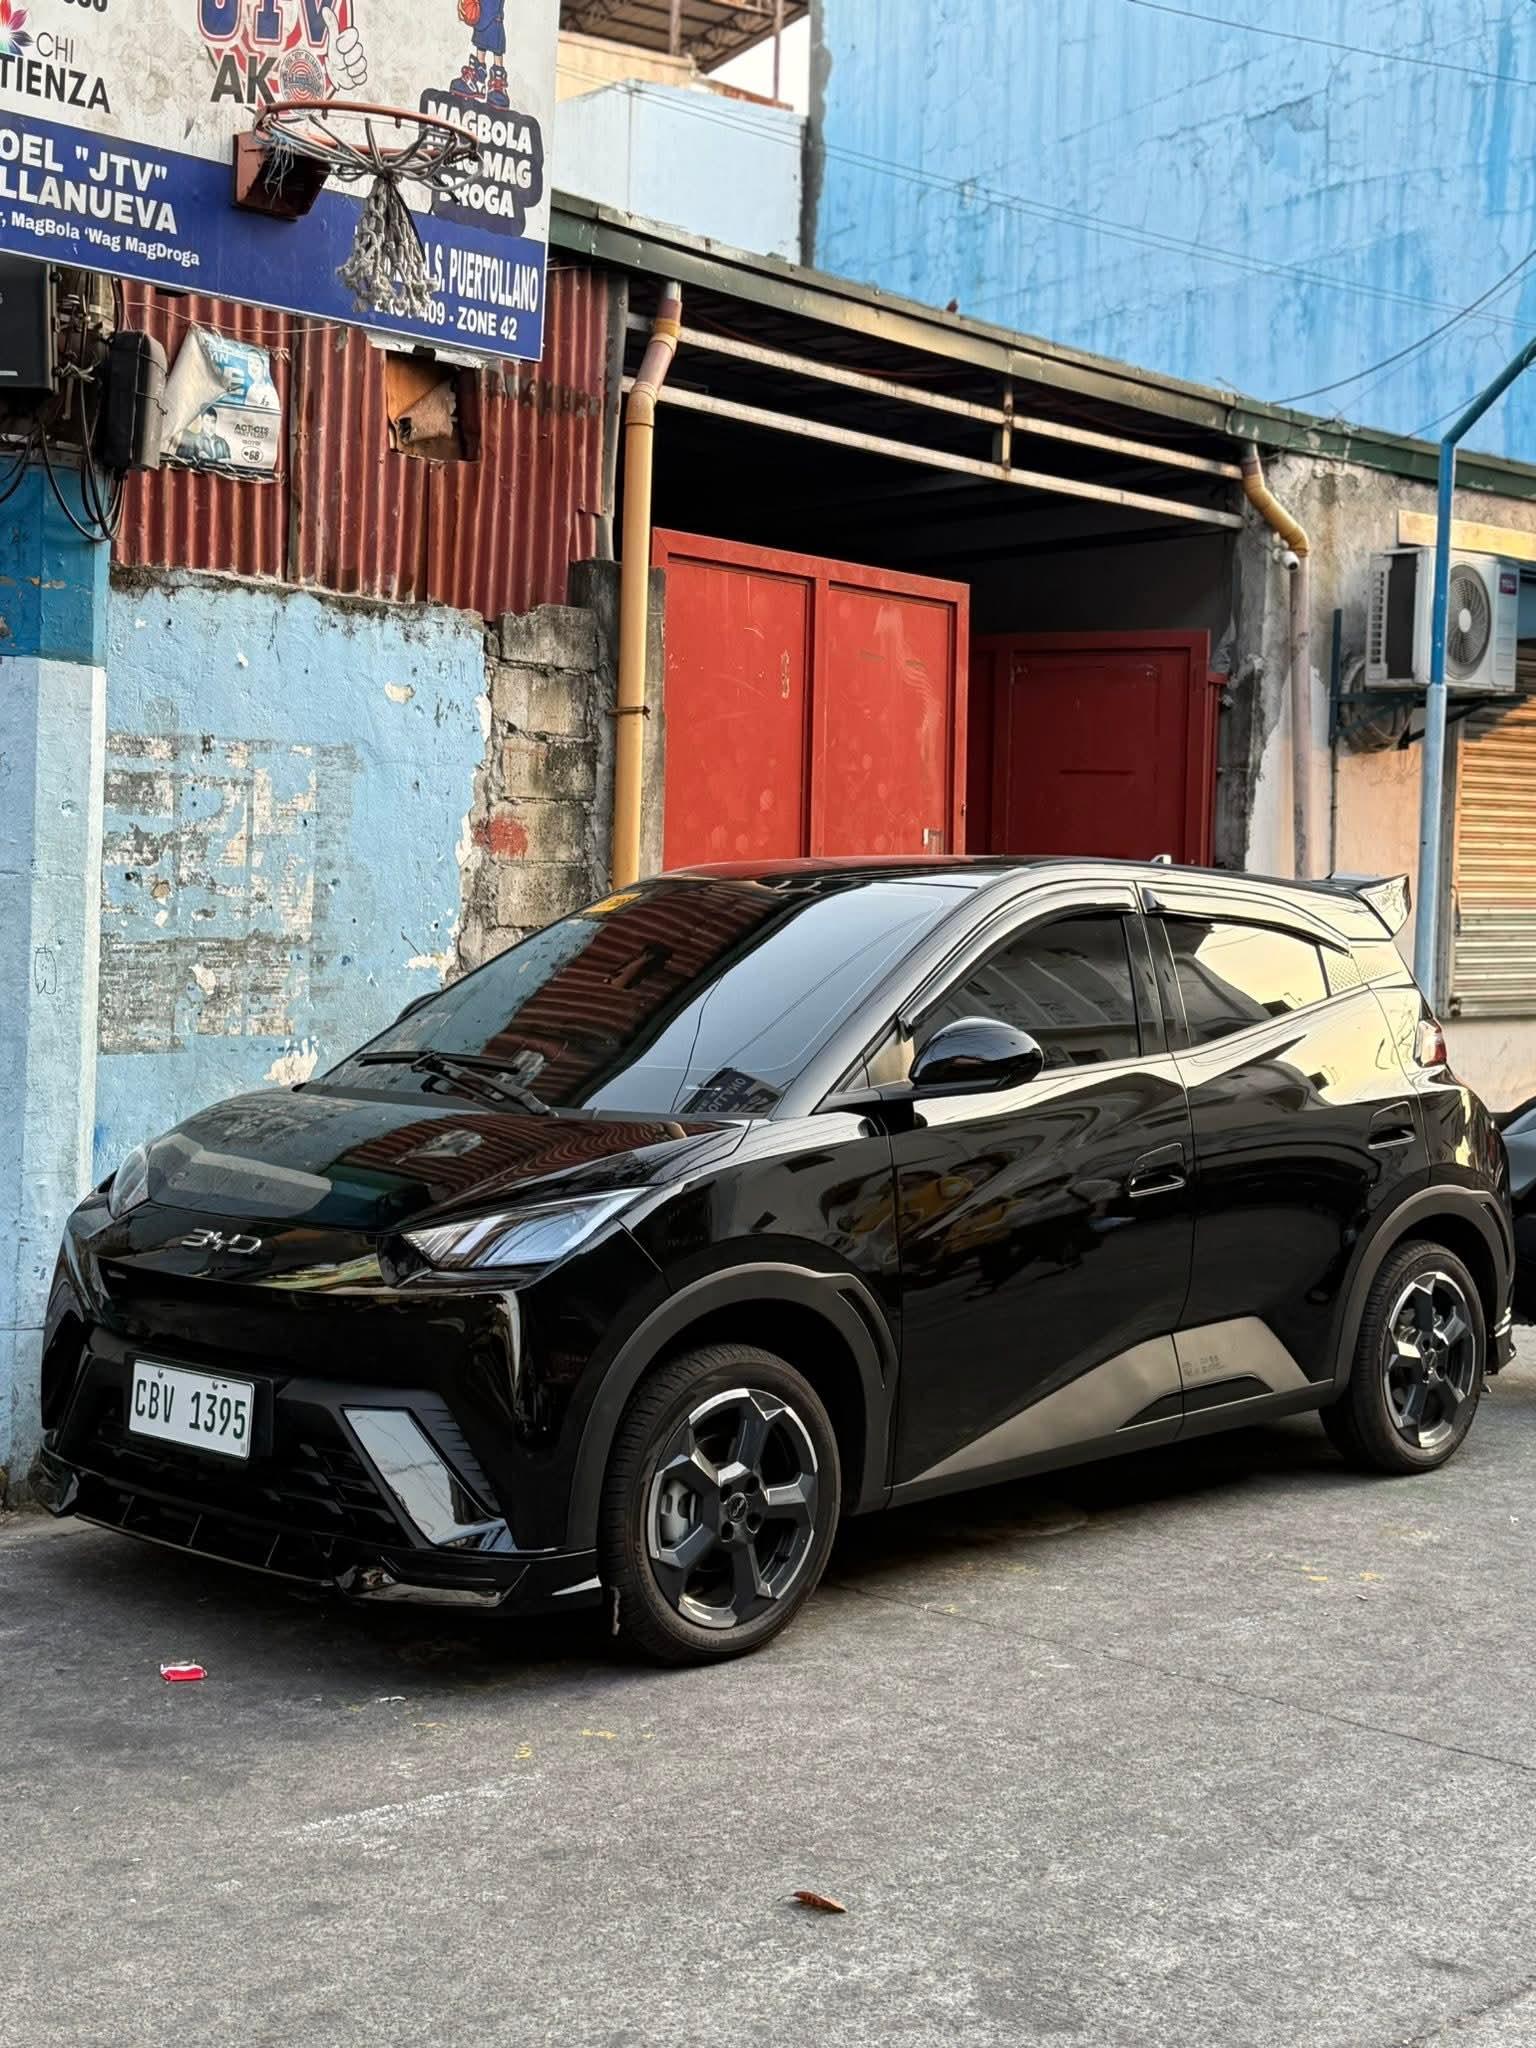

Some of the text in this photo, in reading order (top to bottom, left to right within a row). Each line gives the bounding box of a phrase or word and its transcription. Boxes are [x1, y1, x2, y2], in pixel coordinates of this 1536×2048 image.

[36, 32, 74, 64] CHI
[0, 52, 111, 114] TIENZA
[427, 100, 533, 155] MAGBOLA
[75, 145, 168, 192] "JTV"
[482, 150, 532, 189] MAG
[0, 165, 177, 235] LLANUEVA
[11, 211, 81, 241] MagBola
[125, 236, 200, 267] MagDroga
[450, 248, 539, 313] PUERTOLLANO
[457, 306, 497, 336] ZONE
[500, 316, 518, 341] 42
[135, 1379, 247, 1440] CBV 1395
